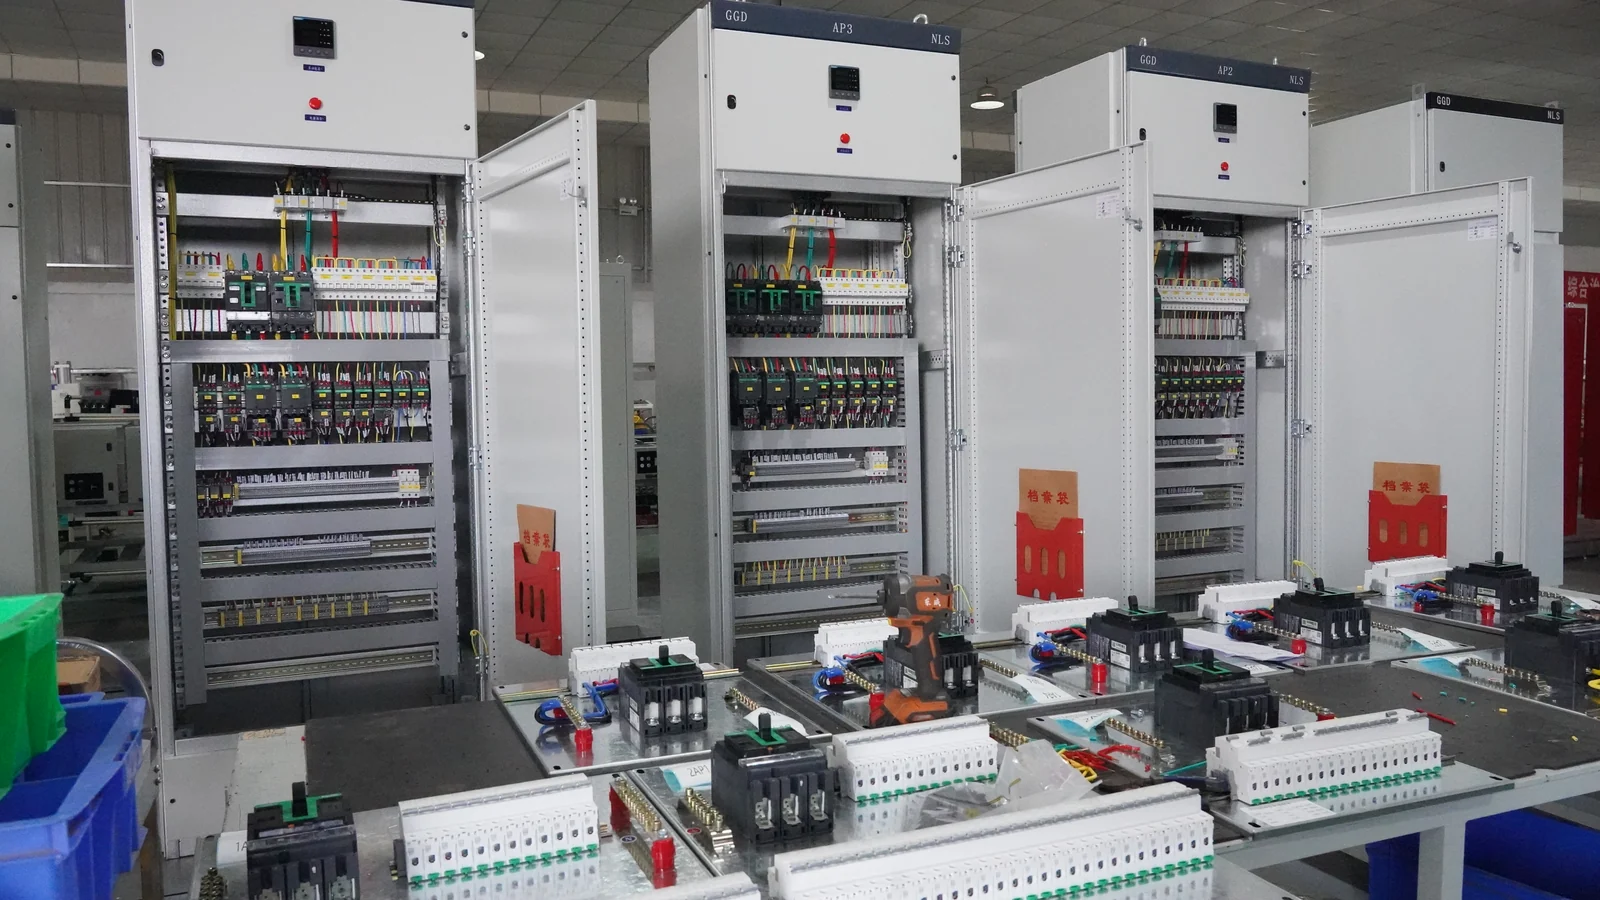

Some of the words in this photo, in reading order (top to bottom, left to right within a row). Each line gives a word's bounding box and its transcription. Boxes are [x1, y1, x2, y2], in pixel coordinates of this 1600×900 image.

[725, 9, 748, 22] GGD
[832, 22, 853, 34] AP3
[931, 33, 950, 46] NLS
[1140, 54, 1157, 66] GGD
[1217, 65, 1233, 76] AP2
[1289, 75, 1304, 85] NLS
[1436, 95, 1451, 106] GGD
[1547, 110, 1560, 121] NLS
[1027, 488, 1070, 505] 档案袋
[1382, 479, 1430, 493] 档案袋
[523, 529, 551, 549] 档案袋
